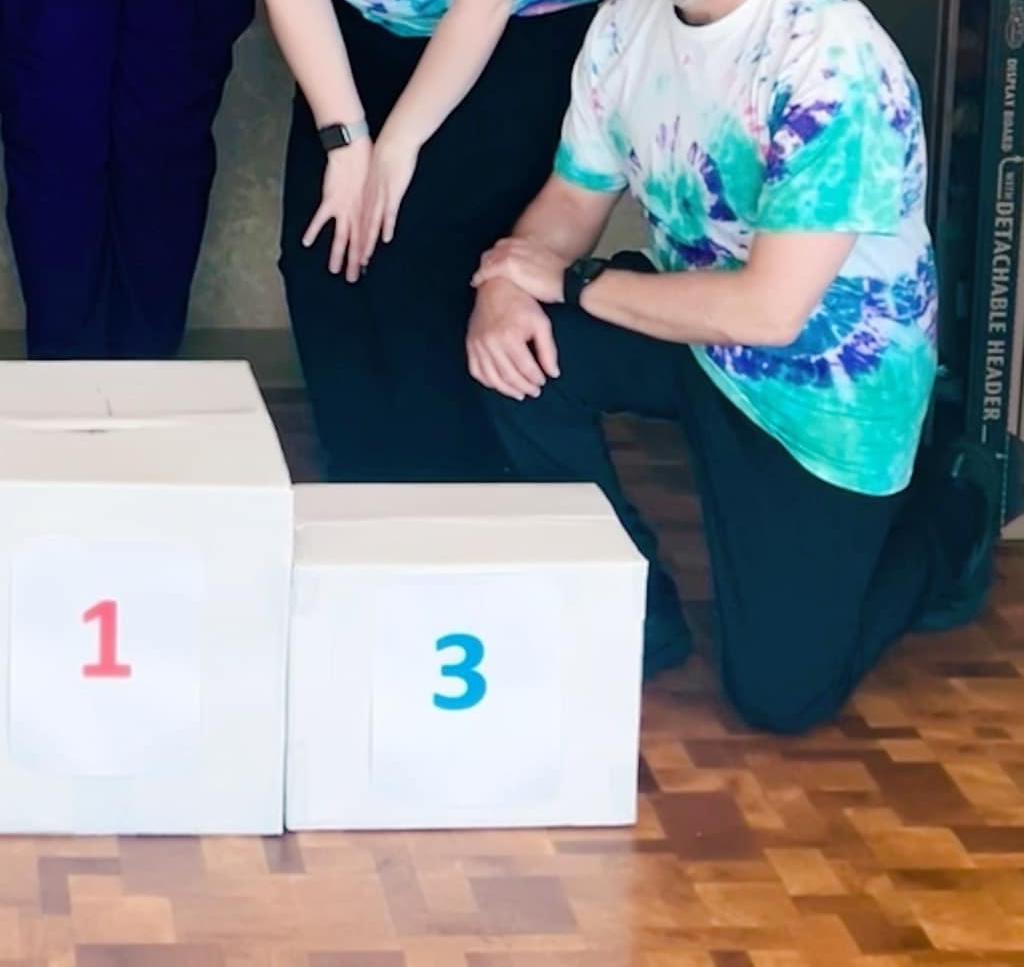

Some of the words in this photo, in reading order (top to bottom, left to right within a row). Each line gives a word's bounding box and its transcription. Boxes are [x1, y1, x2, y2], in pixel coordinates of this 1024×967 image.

[1004, 58, 1018, 107] DISPLAY
[1001, 110, 1015, 153] BOARD
[988, 201, 1015, 333] DETACHABLE
[982, 340, 1006, 421] HEADER
[80, 600, 132, 678] 1
[431, 633, 488, 710] 3
